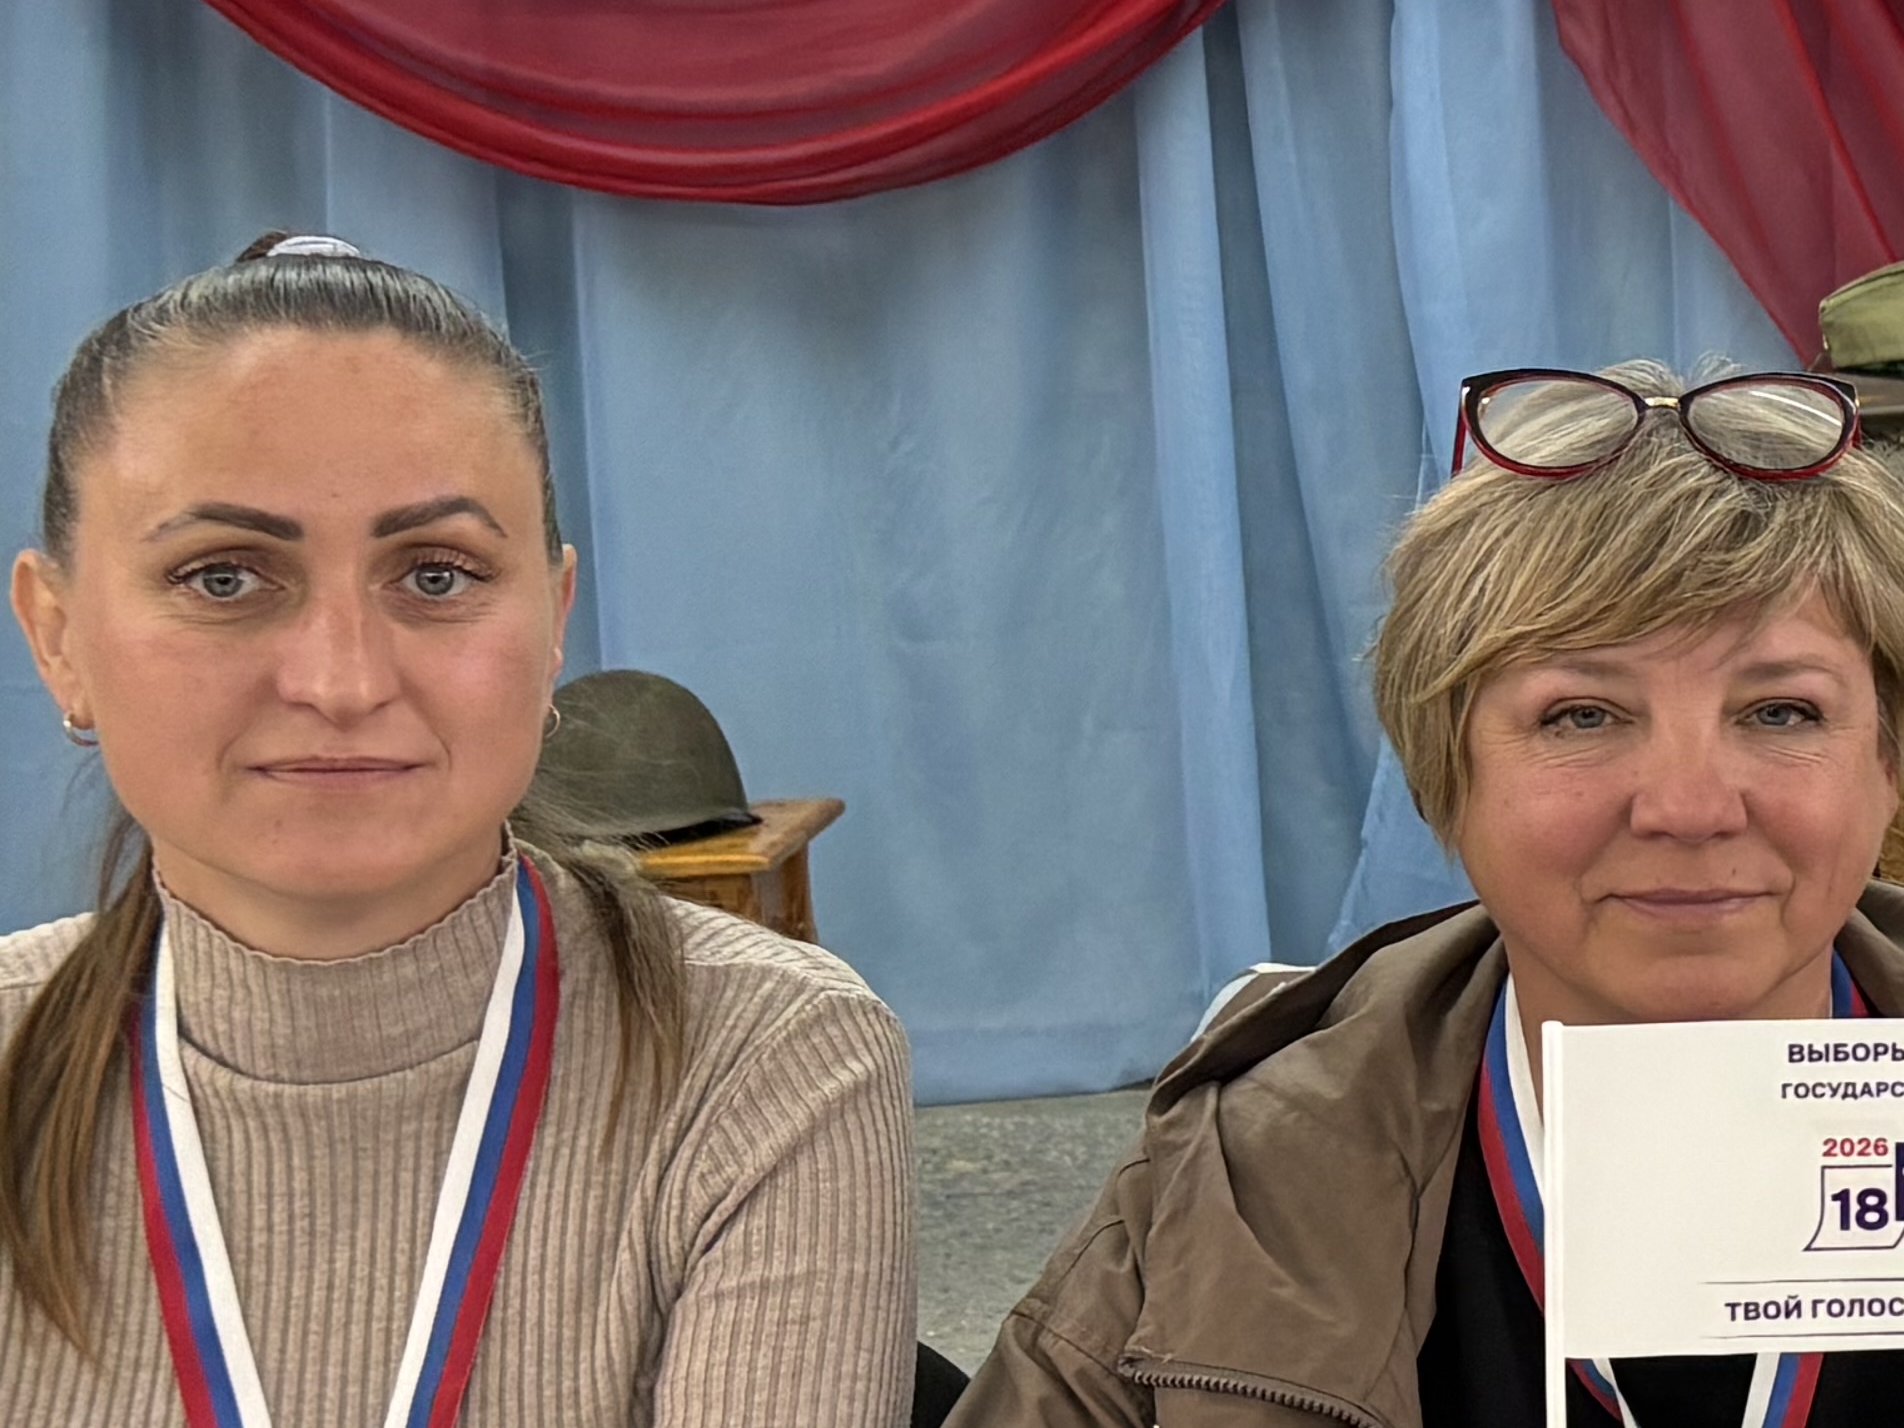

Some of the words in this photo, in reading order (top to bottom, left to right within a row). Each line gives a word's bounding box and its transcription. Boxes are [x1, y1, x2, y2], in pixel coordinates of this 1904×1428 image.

[1822, 1136, 1889, 1159] 2026
[1830, 1187, 1889, 1233] 18
[1725, 1295, 1804, 1322] ТВОЙ
